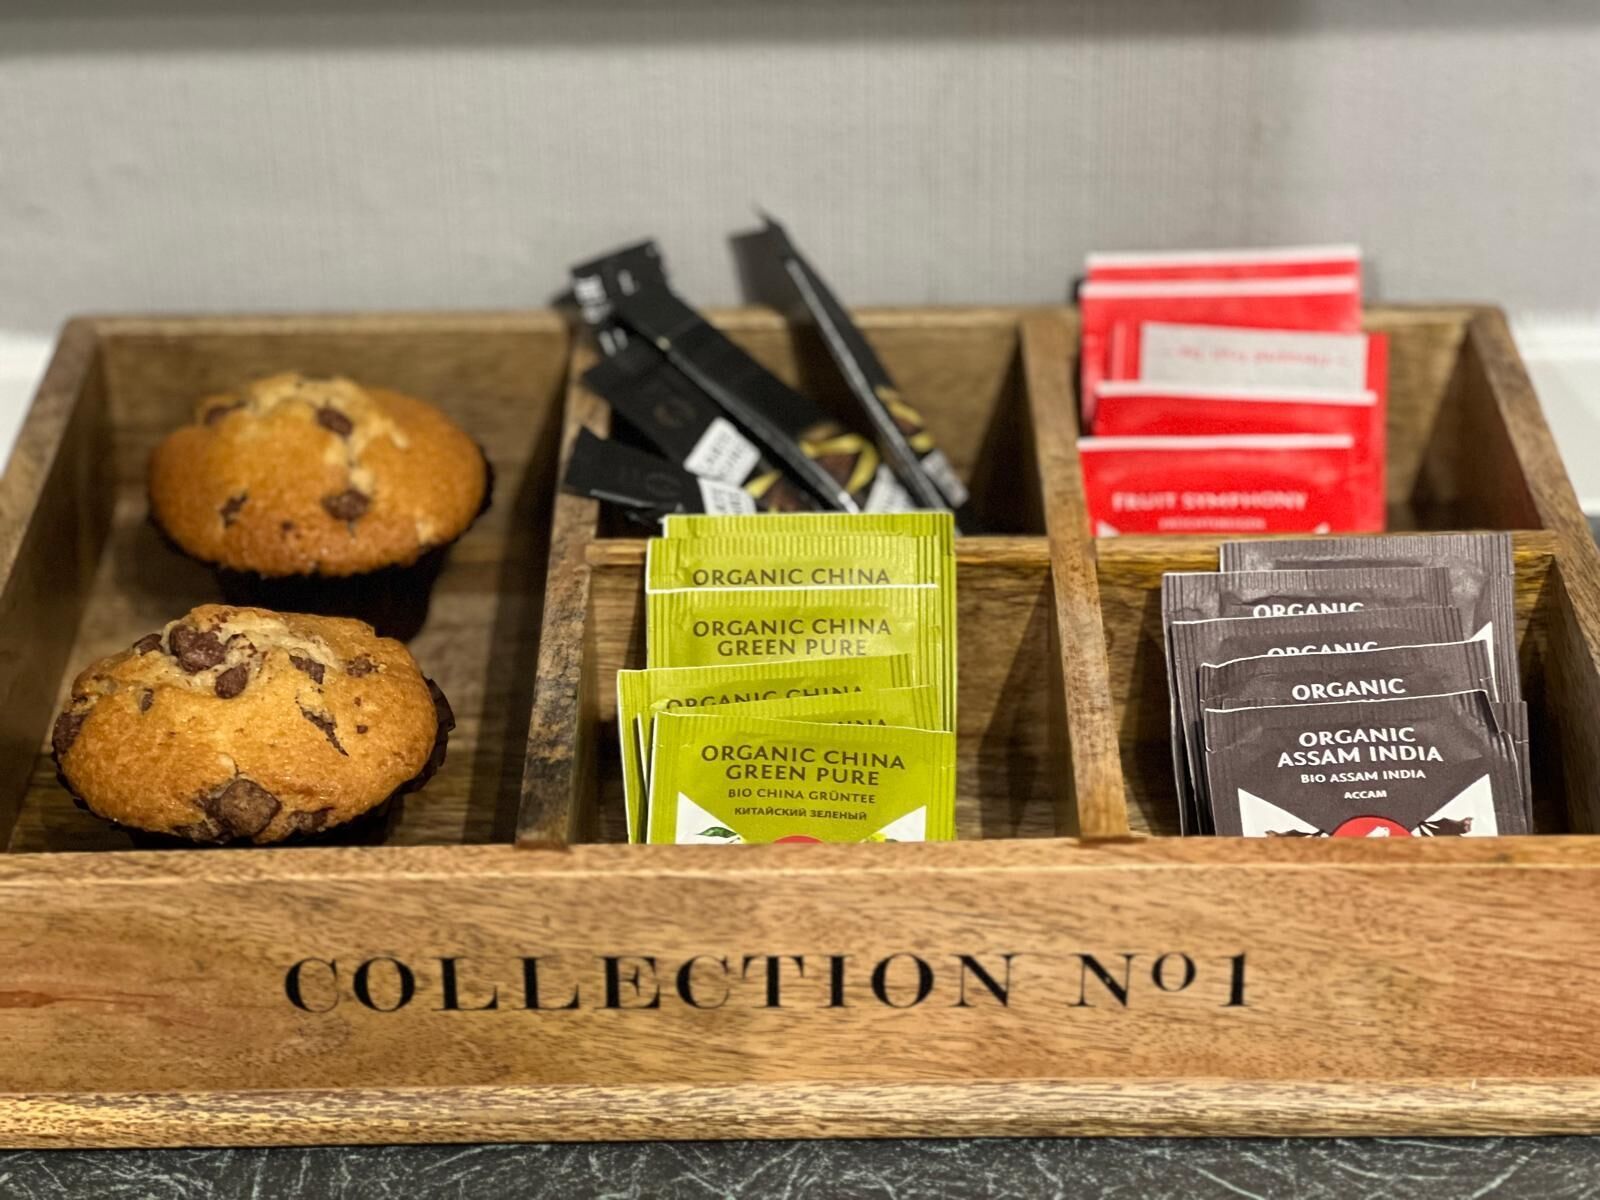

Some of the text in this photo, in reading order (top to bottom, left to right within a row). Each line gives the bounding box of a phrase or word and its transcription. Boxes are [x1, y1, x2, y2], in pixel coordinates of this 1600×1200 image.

[1111, 492, 1175, 511] FRUIT
[692, 568, 890, 586] ORGANIC CHINA
[692, 618, 892, 637] ORGANIC CHINA
[717, 638, 867, 656] GREEN PURE
[1292, 678, 1406, 701] ORGANIC
[1298, 727, 1417, 747] ORGANIC
[702, 744, 905, 770] ORGANIC CHINA
[1277, 745, 1444, 768] ASSAM INDIA
[726, 764, 880, 786] GREEN PURE
[1301, 769, 1426, 784] BIO ASSAM INDIA
[728, 788, 876, 804] BIO CHINA GRÜNTEE
[734, 805, 868, 821] КИТАЙСКИЙ ЗЕЛЕНЫЙ
[284, 953, 1018, 1013] COLLECTION
